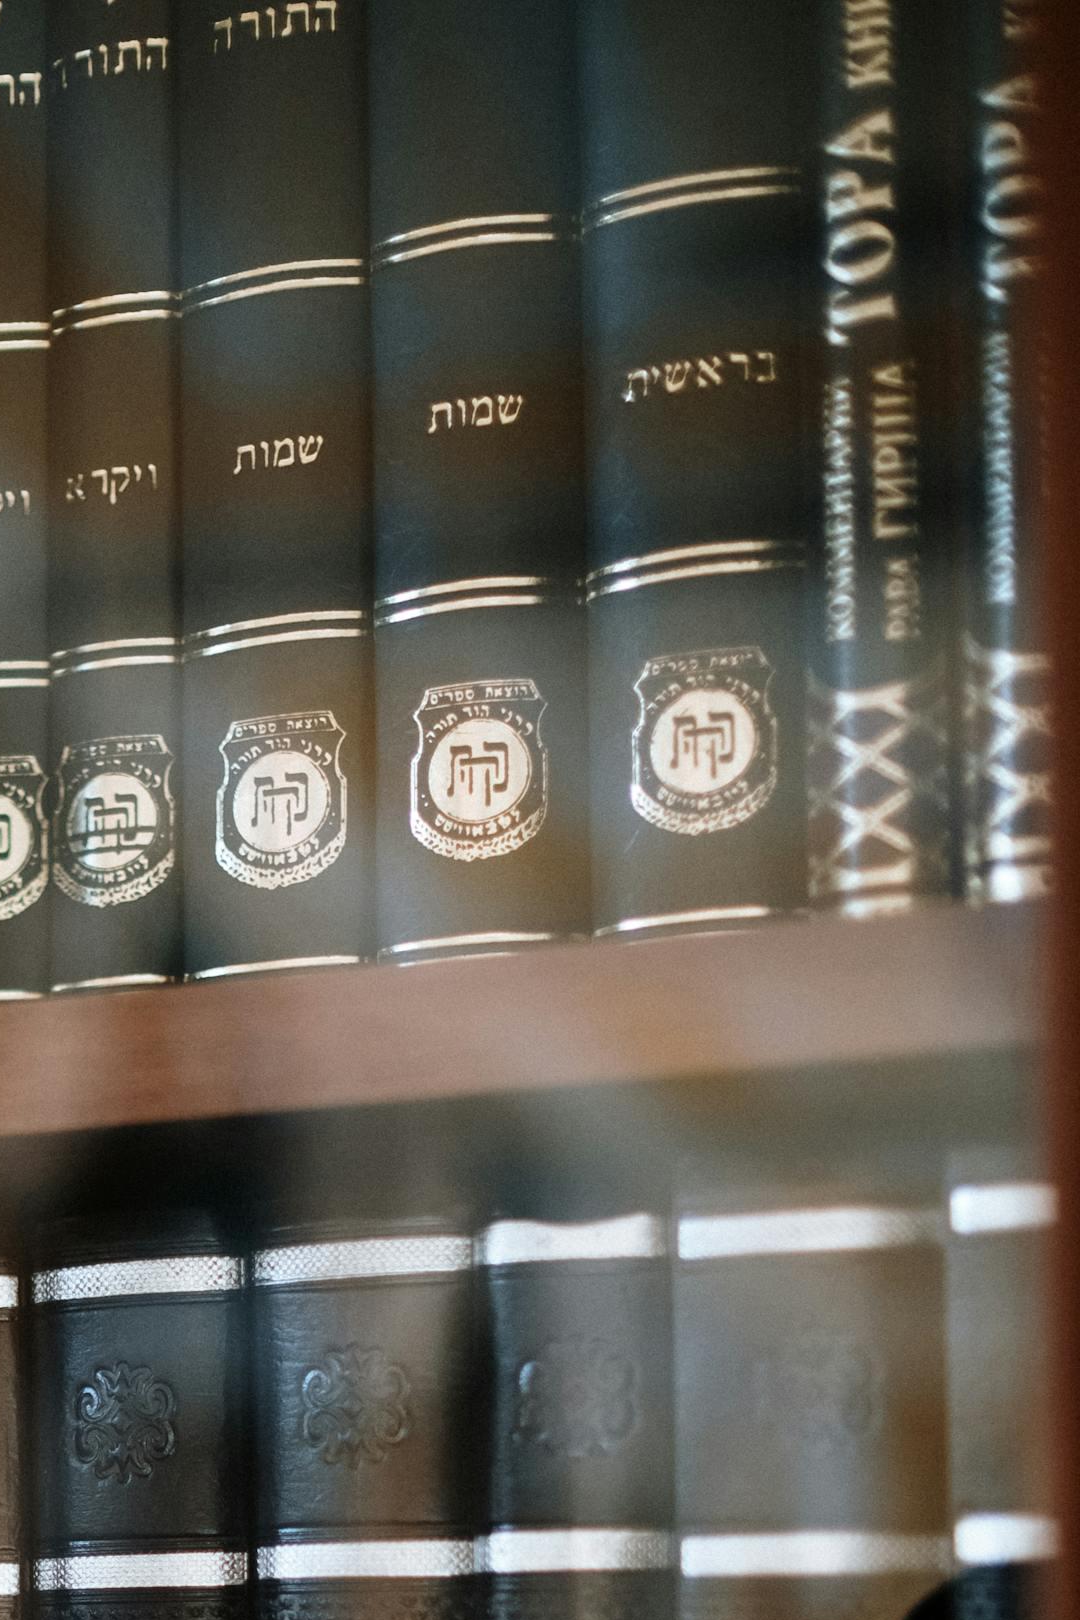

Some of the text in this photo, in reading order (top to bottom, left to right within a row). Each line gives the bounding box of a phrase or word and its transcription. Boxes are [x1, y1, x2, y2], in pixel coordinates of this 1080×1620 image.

[214, 0, 338, 55] התורה
[822, 106, 896, 347] ТОРА
[620, 351, 777, 402] בראשית
[428, 395, 524, 434] שמות
[233, 435, 324, 475] שמות
[66, 463, 159, 505] ויקרא
